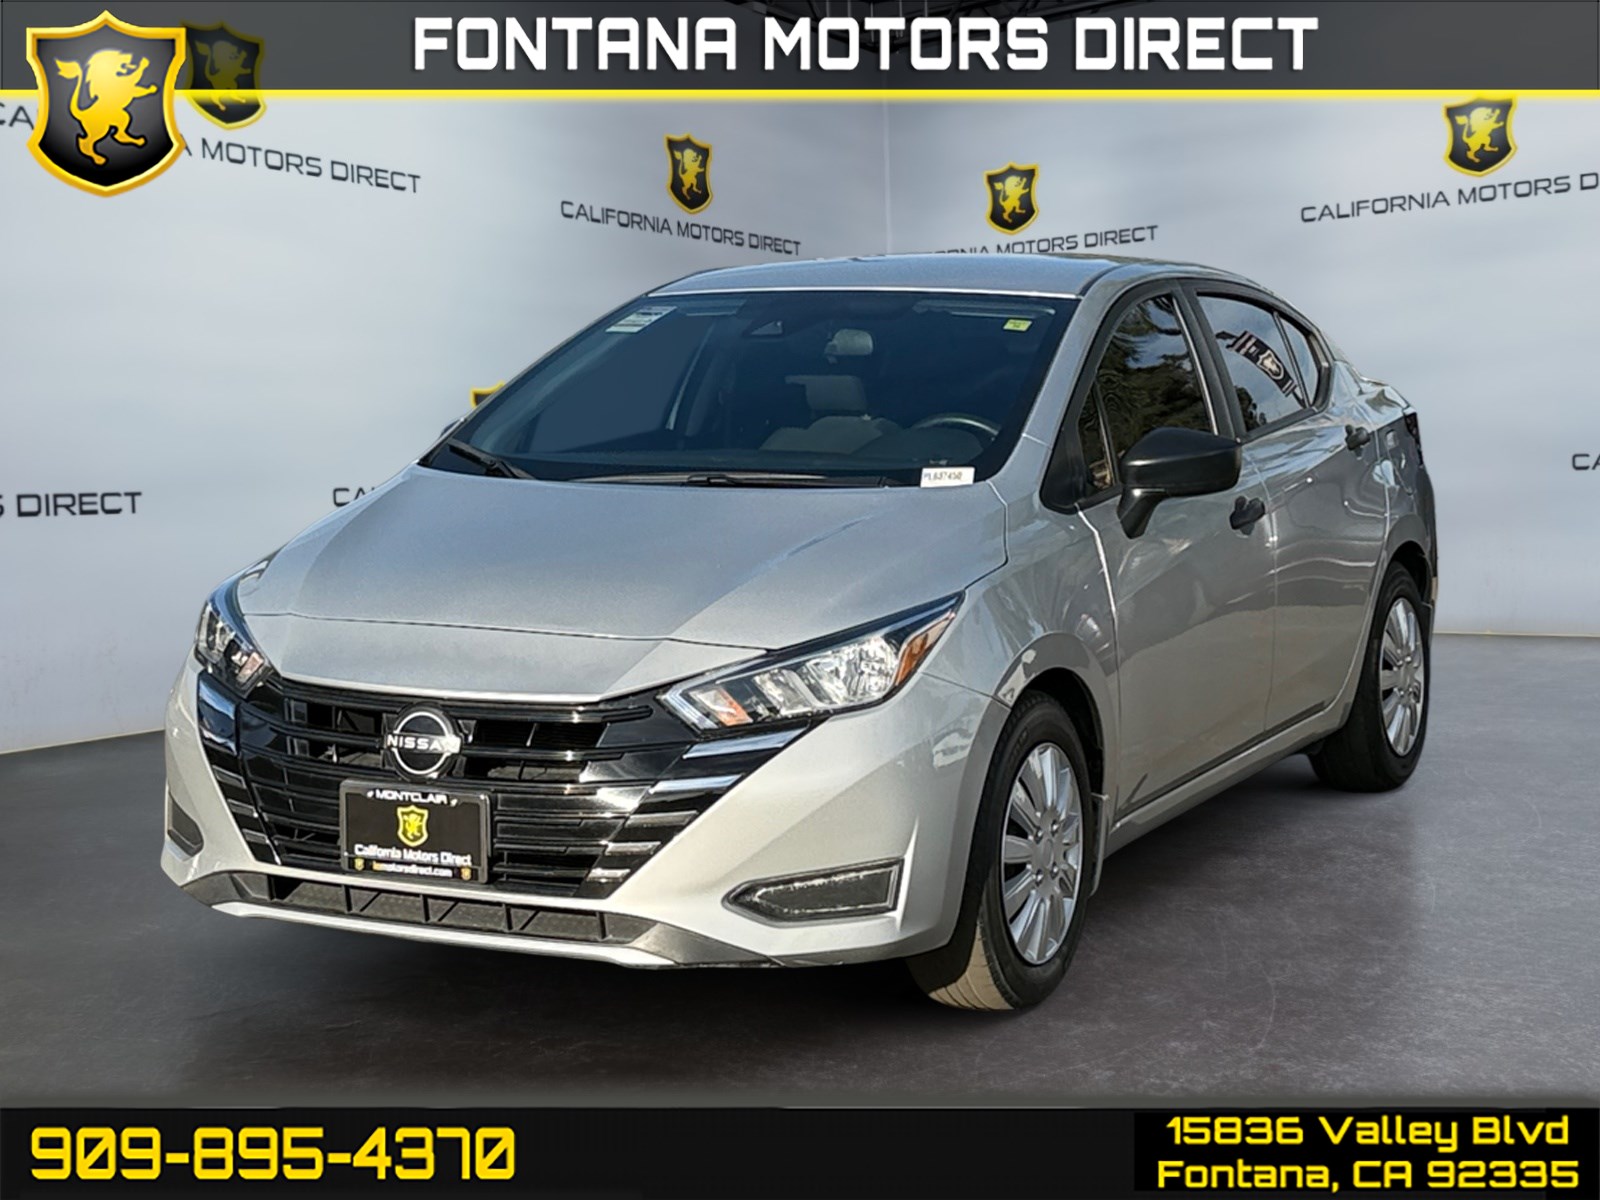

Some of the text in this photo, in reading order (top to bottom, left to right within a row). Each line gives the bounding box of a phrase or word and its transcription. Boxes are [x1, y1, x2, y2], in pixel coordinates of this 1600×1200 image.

[201, 137, 323, 178] MOTORS
[330, 160, 421, 194] DIRECT
[1300, 190, 1451, 223] CALIFORNIA
[1458, 175, 1571, 205] MOTORS
[560, 200, 801, 256] CALIFORNIA MOTORS DIRECT
[997, 235, 1078, 253] MOTORS
[1084, 225, 1158, 249] DIRECT
[16, 491, 143, 518] DIRECT
[375, 789, 448, 804] MONTCLAIR
[354, 843, 472, 866] California Motors Direct
